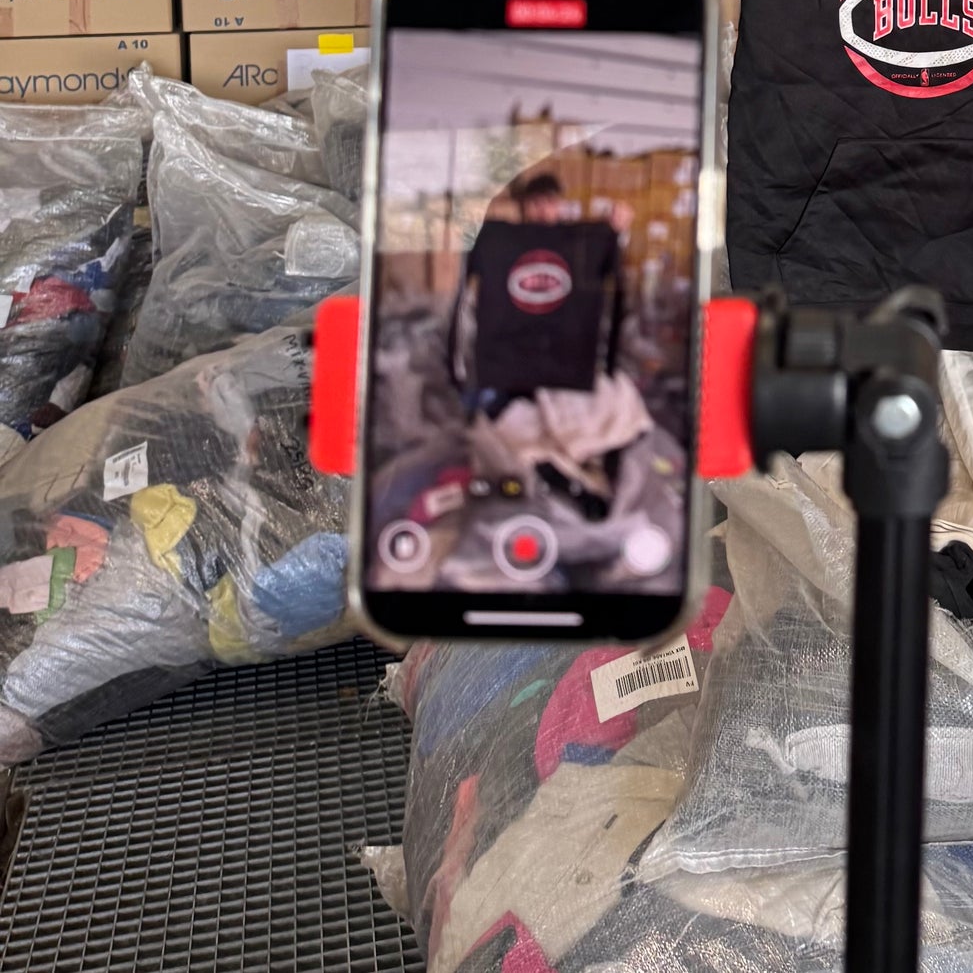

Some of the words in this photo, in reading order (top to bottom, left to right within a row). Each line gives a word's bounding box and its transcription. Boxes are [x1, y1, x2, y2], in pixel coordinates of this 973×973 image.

[214, 17, 230, 27] 10
[235, 17, 244, 26] A
[118, 40, 127, 50] A
[132, 39, 148, 49] 10
